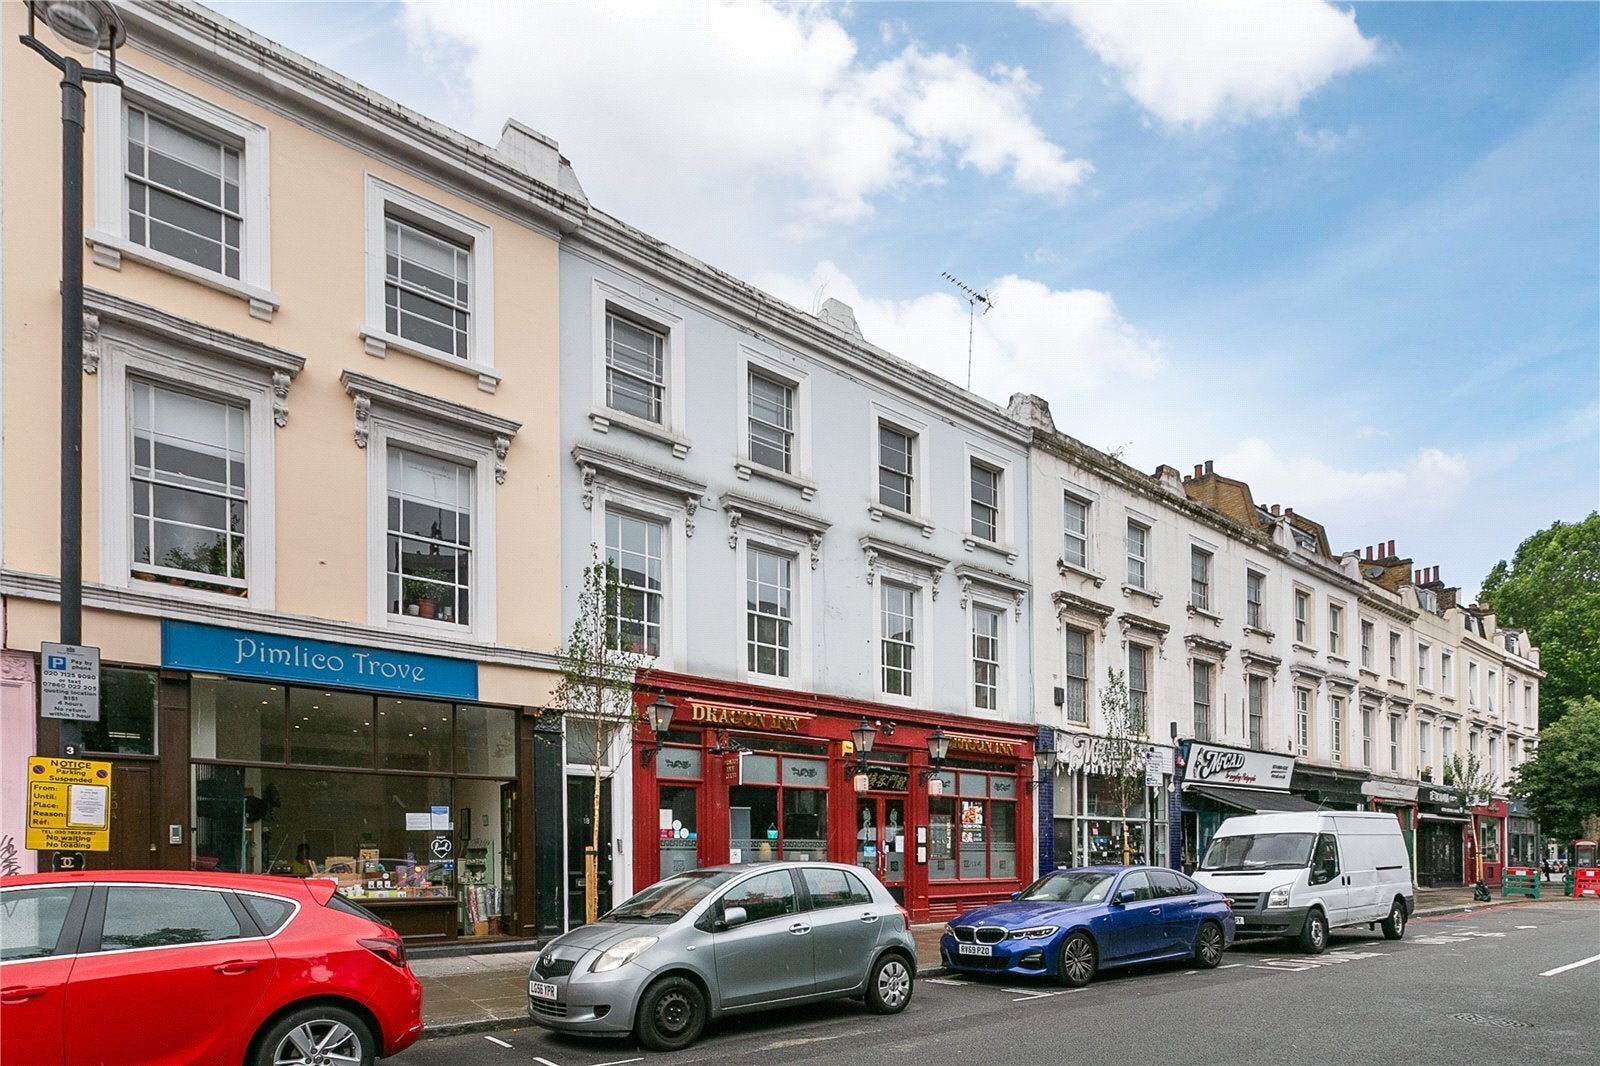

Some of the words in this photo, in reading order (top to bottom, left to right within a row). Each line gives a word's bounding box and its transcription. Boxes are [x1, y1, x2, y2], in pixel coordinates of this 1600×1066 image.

[52, 657, 64, 668] P
[235, 637, 344, 672] Pimlico
[352, 652, 426, 683] Trove
[691, 703, 765, 728] DRAGON
[771, 715, 800, 731] INN
[66, 746, 74, 755] 3
[51, 760, 92, 770] NOTICE
[56, 768, 86, 777] Parking
[49, 775, 93, 784] Suspended
[32, 810, 66, 818] Reason:
